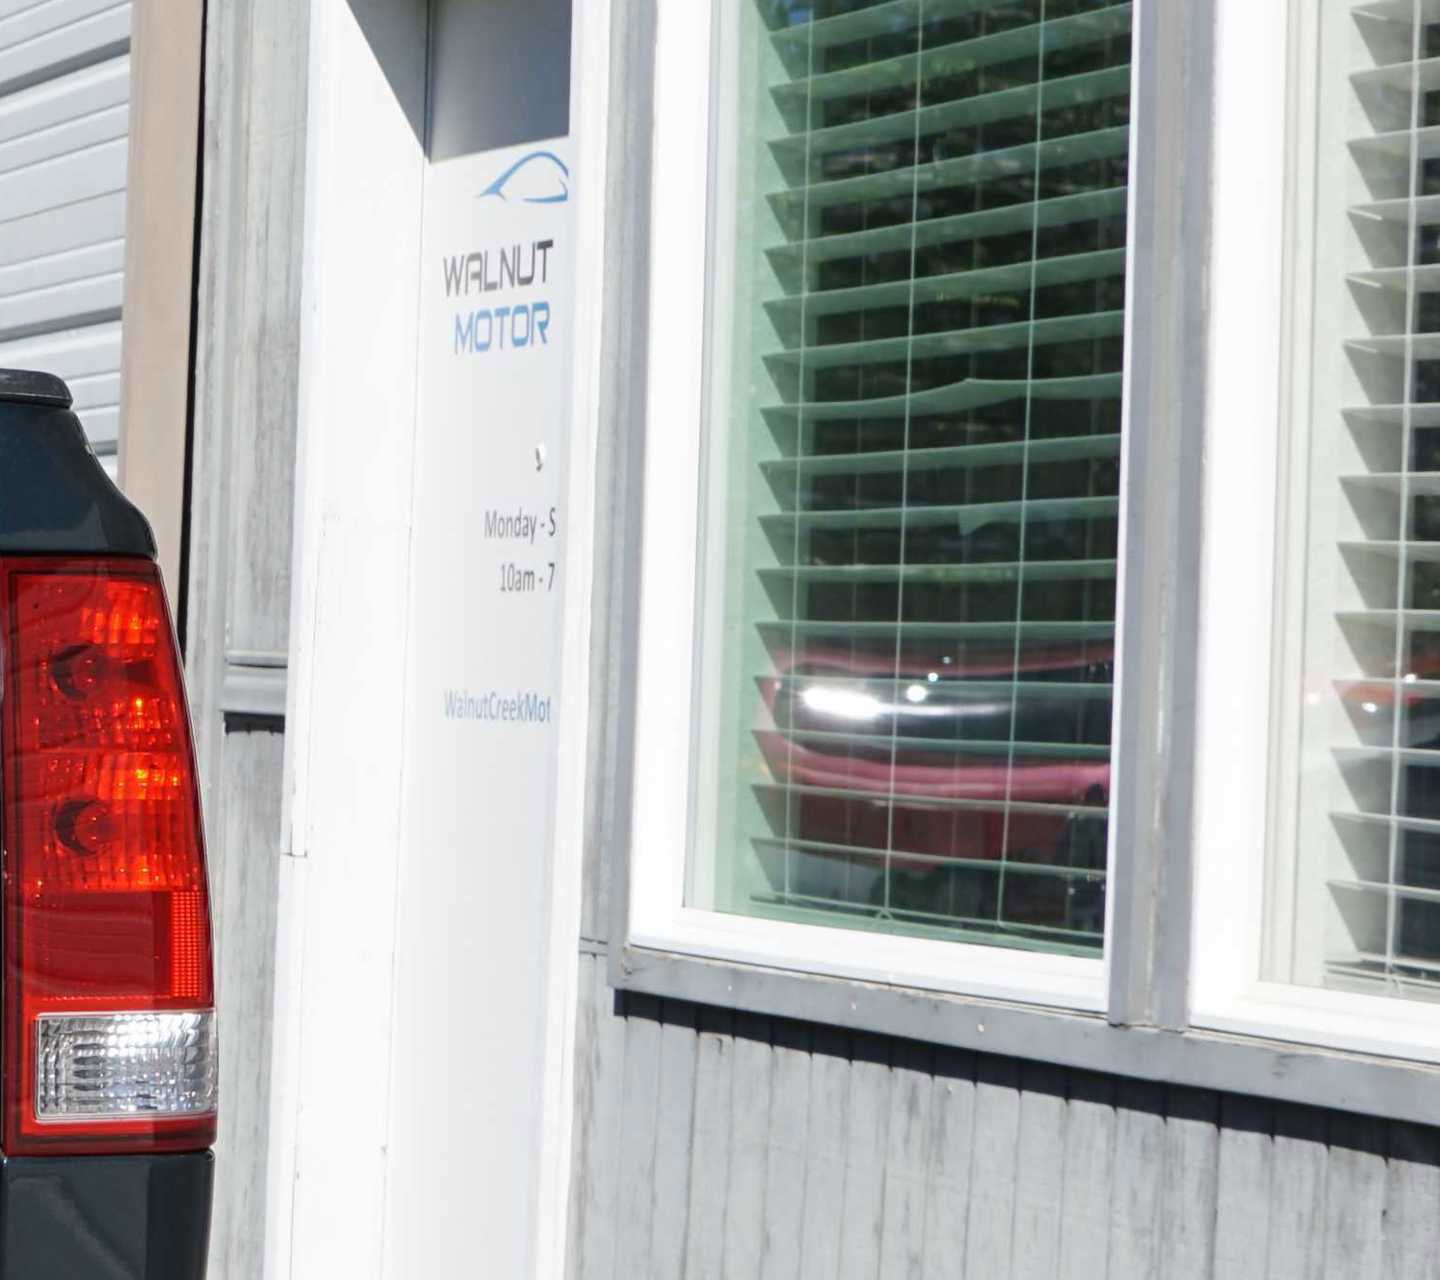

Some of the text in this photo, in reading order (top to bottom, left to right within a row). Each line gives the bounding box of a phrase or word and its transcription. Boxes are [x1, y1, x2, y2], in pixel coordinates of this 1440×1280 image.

[442, 239, 554, 297] WALNUT
[454, 301, 551, 355] MOTOR
[484, 507, 537, 545] Monday
[500, 562, 535, 592] 10am
